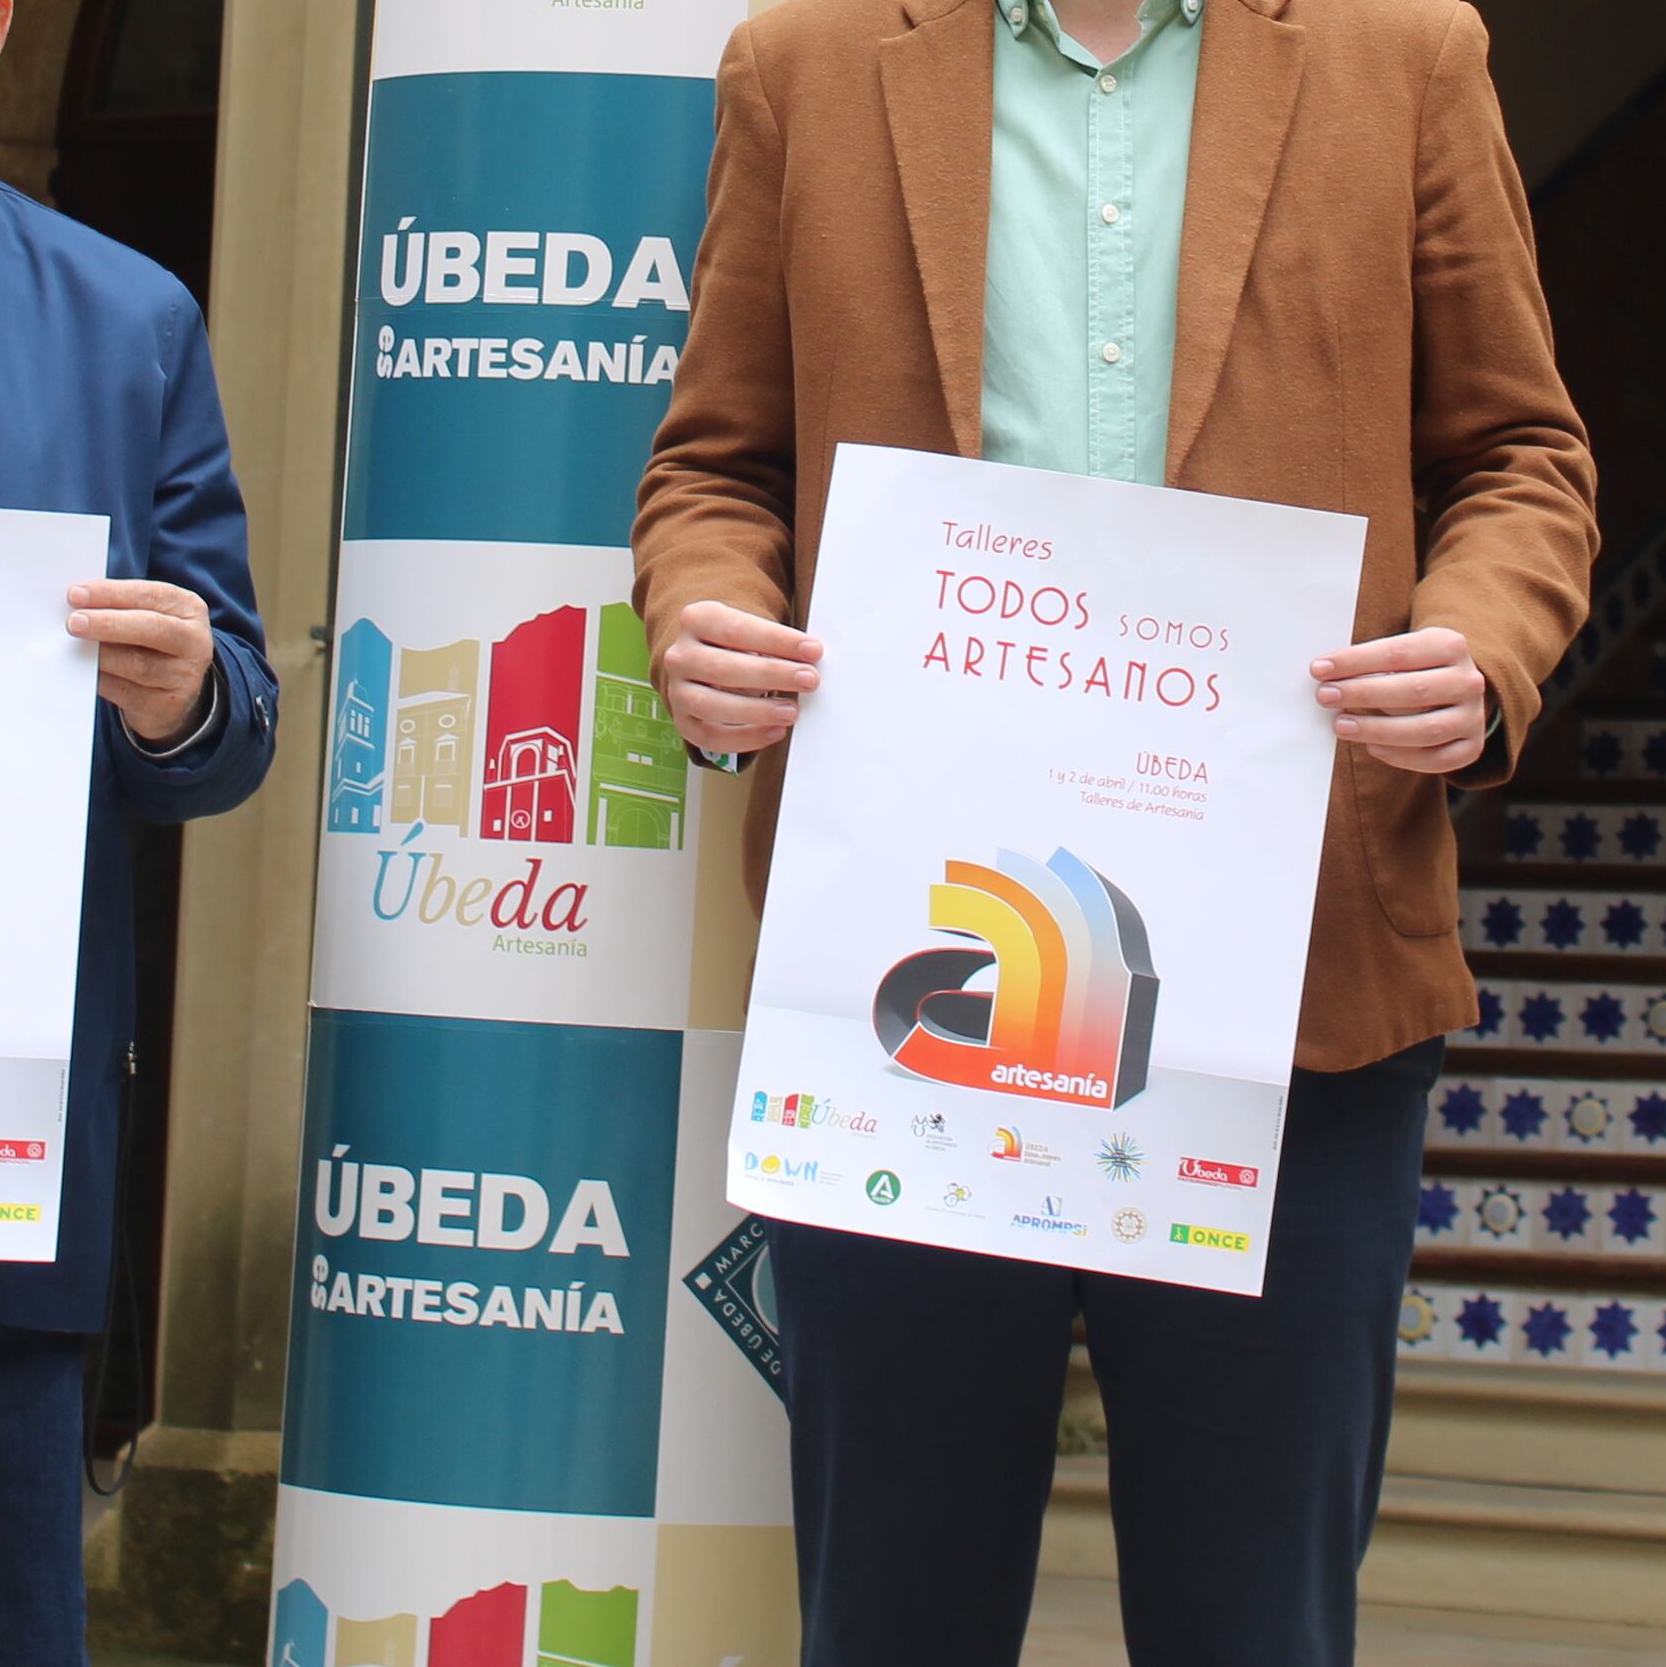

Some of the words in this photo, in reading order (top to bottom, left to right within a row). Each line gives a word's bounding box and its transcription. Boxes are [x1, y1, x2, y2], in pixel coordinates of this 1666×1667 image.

[379, 217, 691, 311] ÚBEDA
[393, 336, 683, 384] ARTESANÍA
[942, 521, 1053, 560] Talleres
[935, 569, 1089, 630] TODOS
[1119, 614, 1229, 652] SOMOS
[923, 631, 1221, 712] ARTESANOS
[1057, 772, 1065, 784] y
[1069, 771, 1077, 783] 2
[1079, 772, 1095, 785] de
[1097, 776, 1126, 790] abril
[1080, 791, 1124, 809] Talleres
[1127, 798, 1142, 811] de
[373, 818, 588, 934] Úbeda
[492, 934, 587, 958] Artesanía
[990, 1063, 1108, 1100] artesanía
[811, 1098, 878, 1134] Úbeda
[315, 1144, 630, 1256] ÚBEDA
[715, 1223, 763, 1273] MARC
[1193, 1230, 1245, 1250] ONCE
[327, 1271, 625, 1335] ARTESANÍA
[713, 1288, 763, 1350] ÚBEDA
